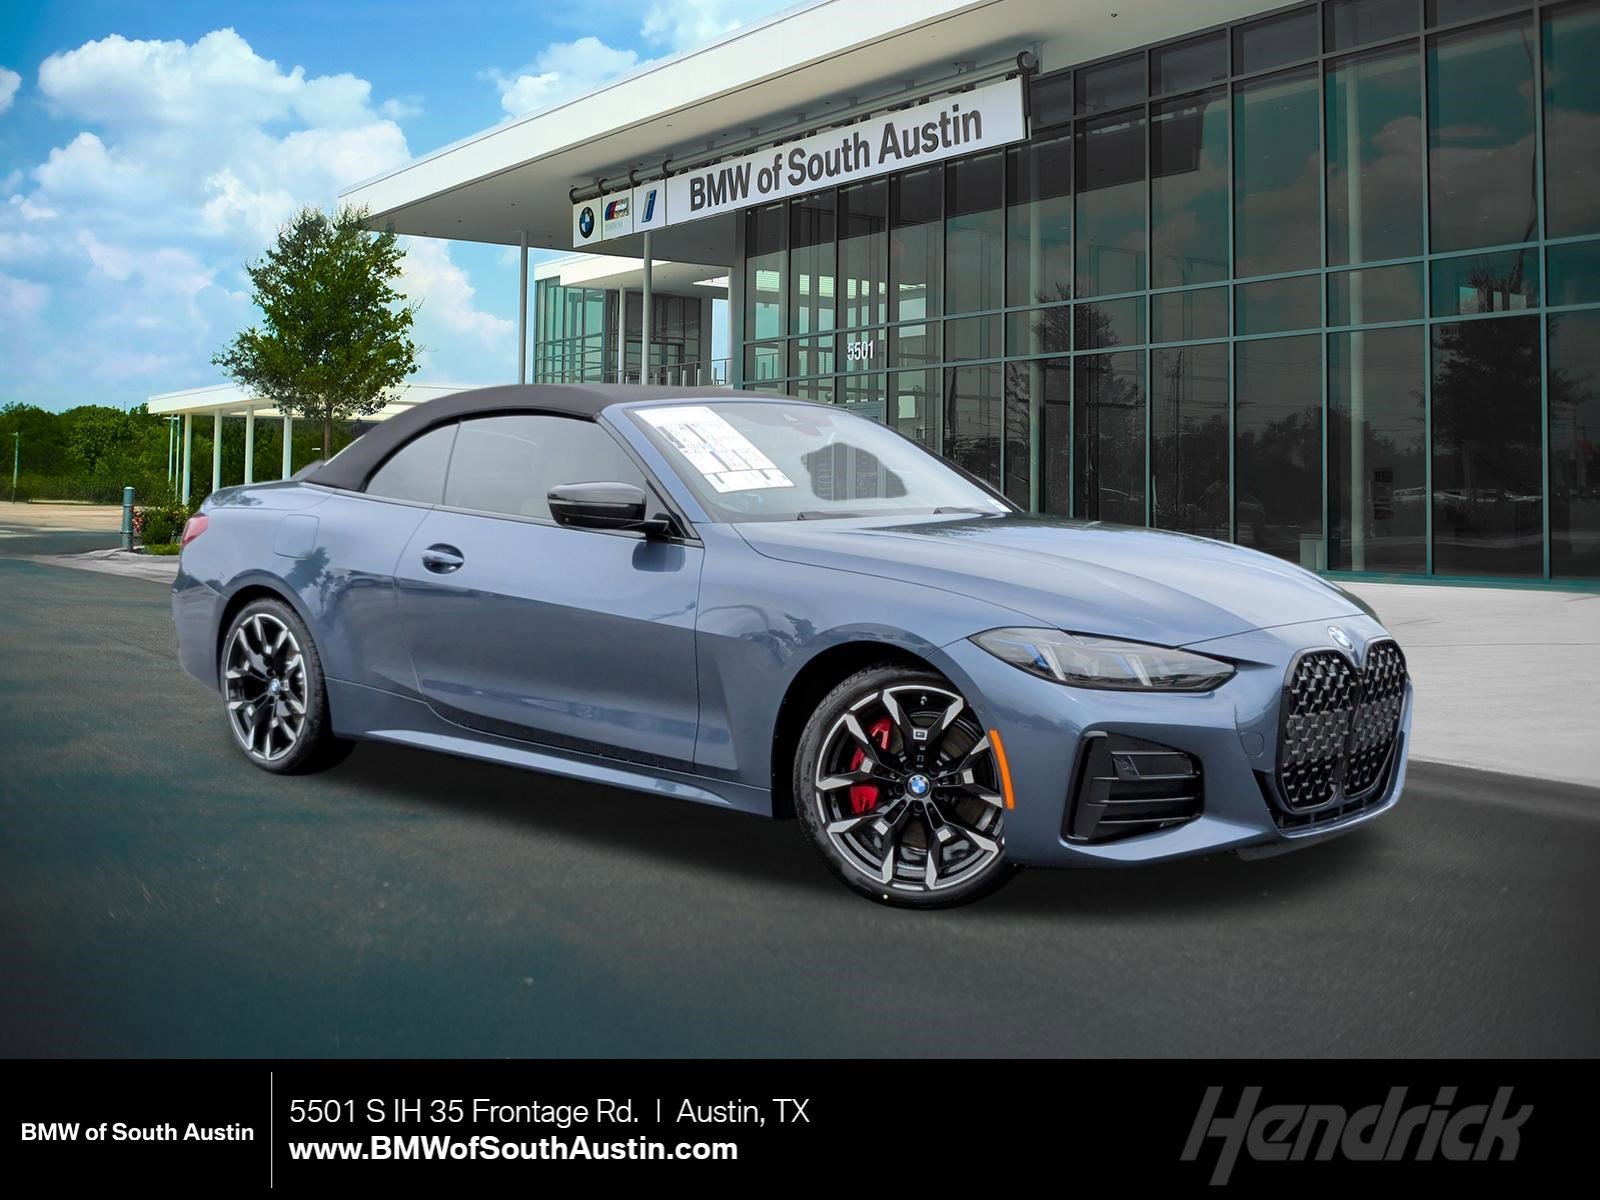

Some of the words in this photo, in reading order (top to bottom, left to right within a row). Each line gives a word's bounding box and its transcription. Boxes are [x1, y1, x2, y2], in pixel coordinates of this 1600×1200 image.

[690, 163, 752, 212] BMW
[757, 153, 783, 195] of
[787, 132, 870, 187] South
[878, 104, 983, 164] Austin
[847, 340, 874, 361] 5501
